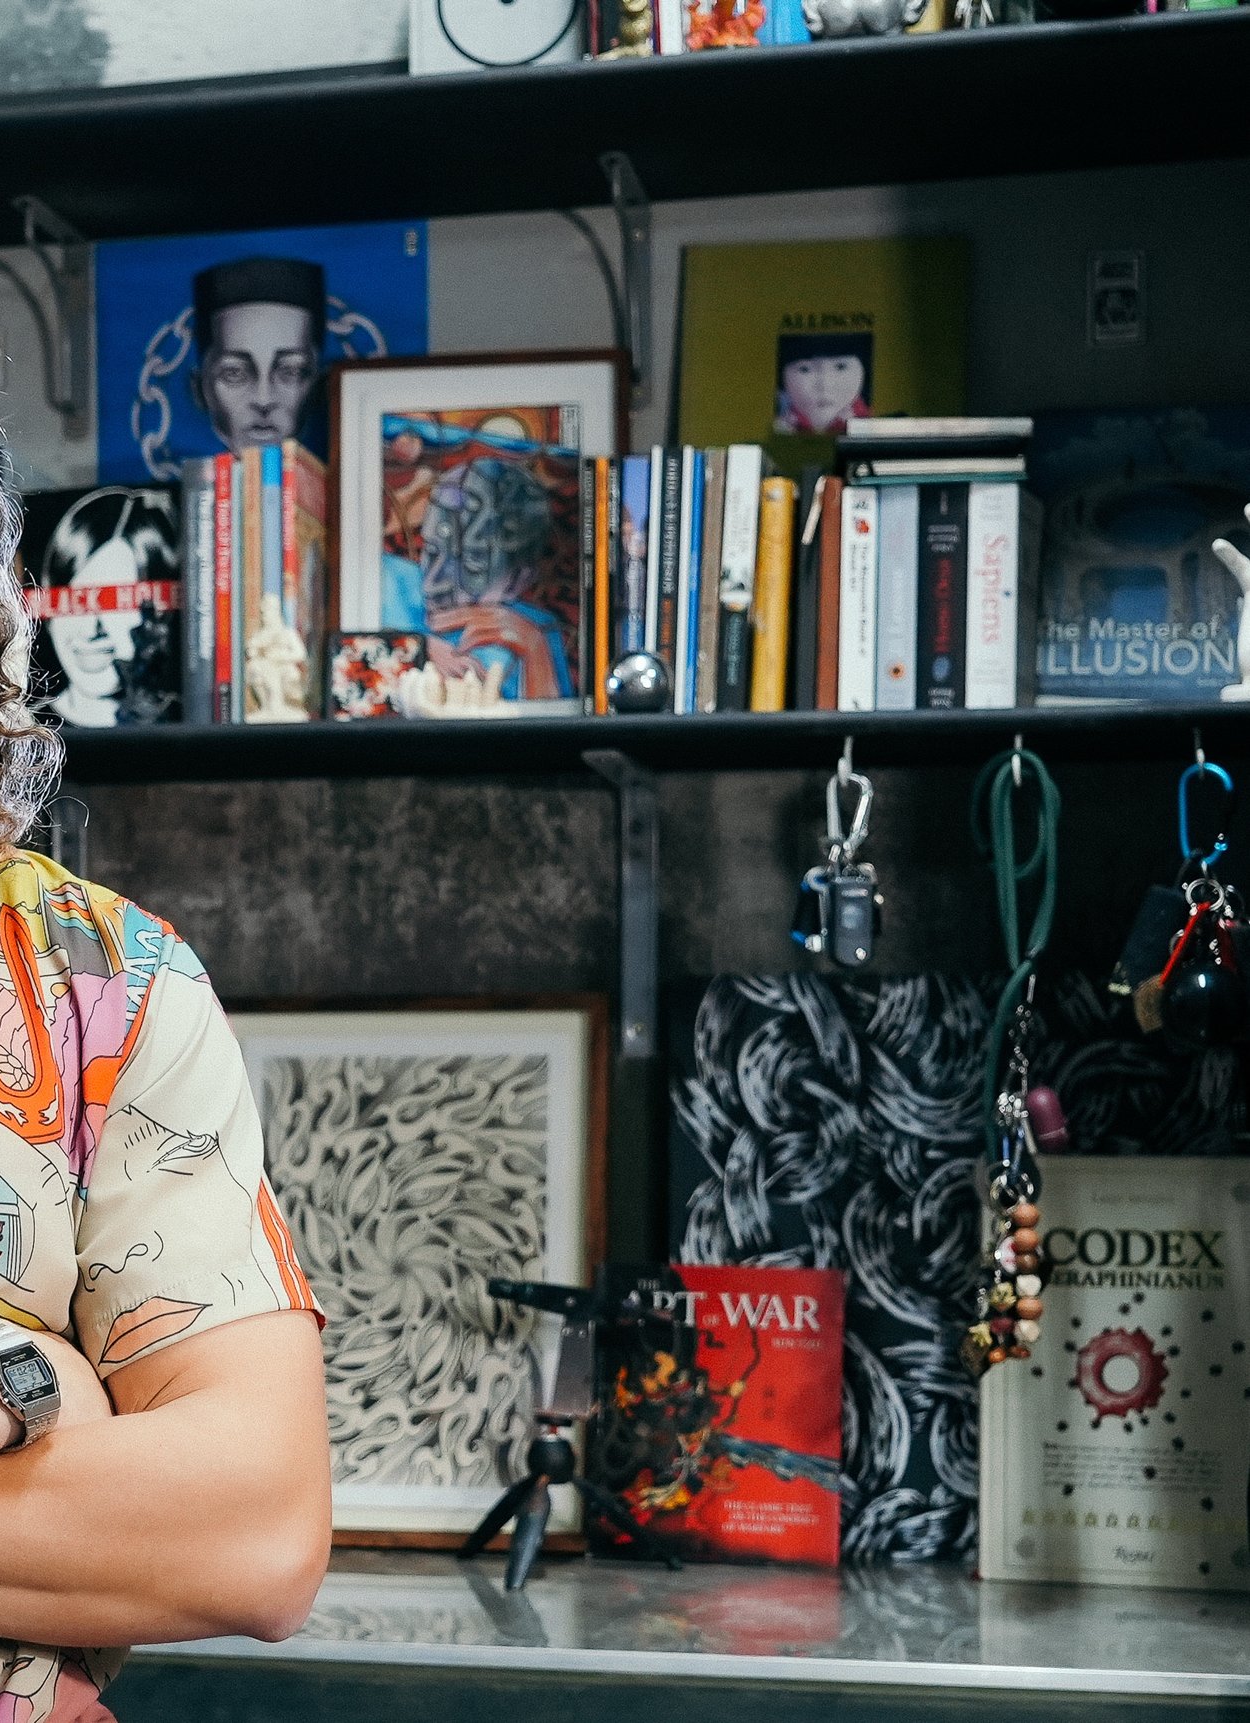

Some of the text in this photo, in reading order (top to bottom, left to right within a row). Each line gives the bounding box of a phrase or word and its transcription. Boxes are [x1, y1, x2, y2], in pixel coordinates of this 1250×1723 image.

[976, 534, 1010, 645] Sapiens
[1048, 613, 1221, 640] he Master of
[1042, 1227, 1225, 1269] CODEX
[1052, 1270, 1224, 1289] ERAPHINIANUS
[719, 1293, 821, 1331] WAR
